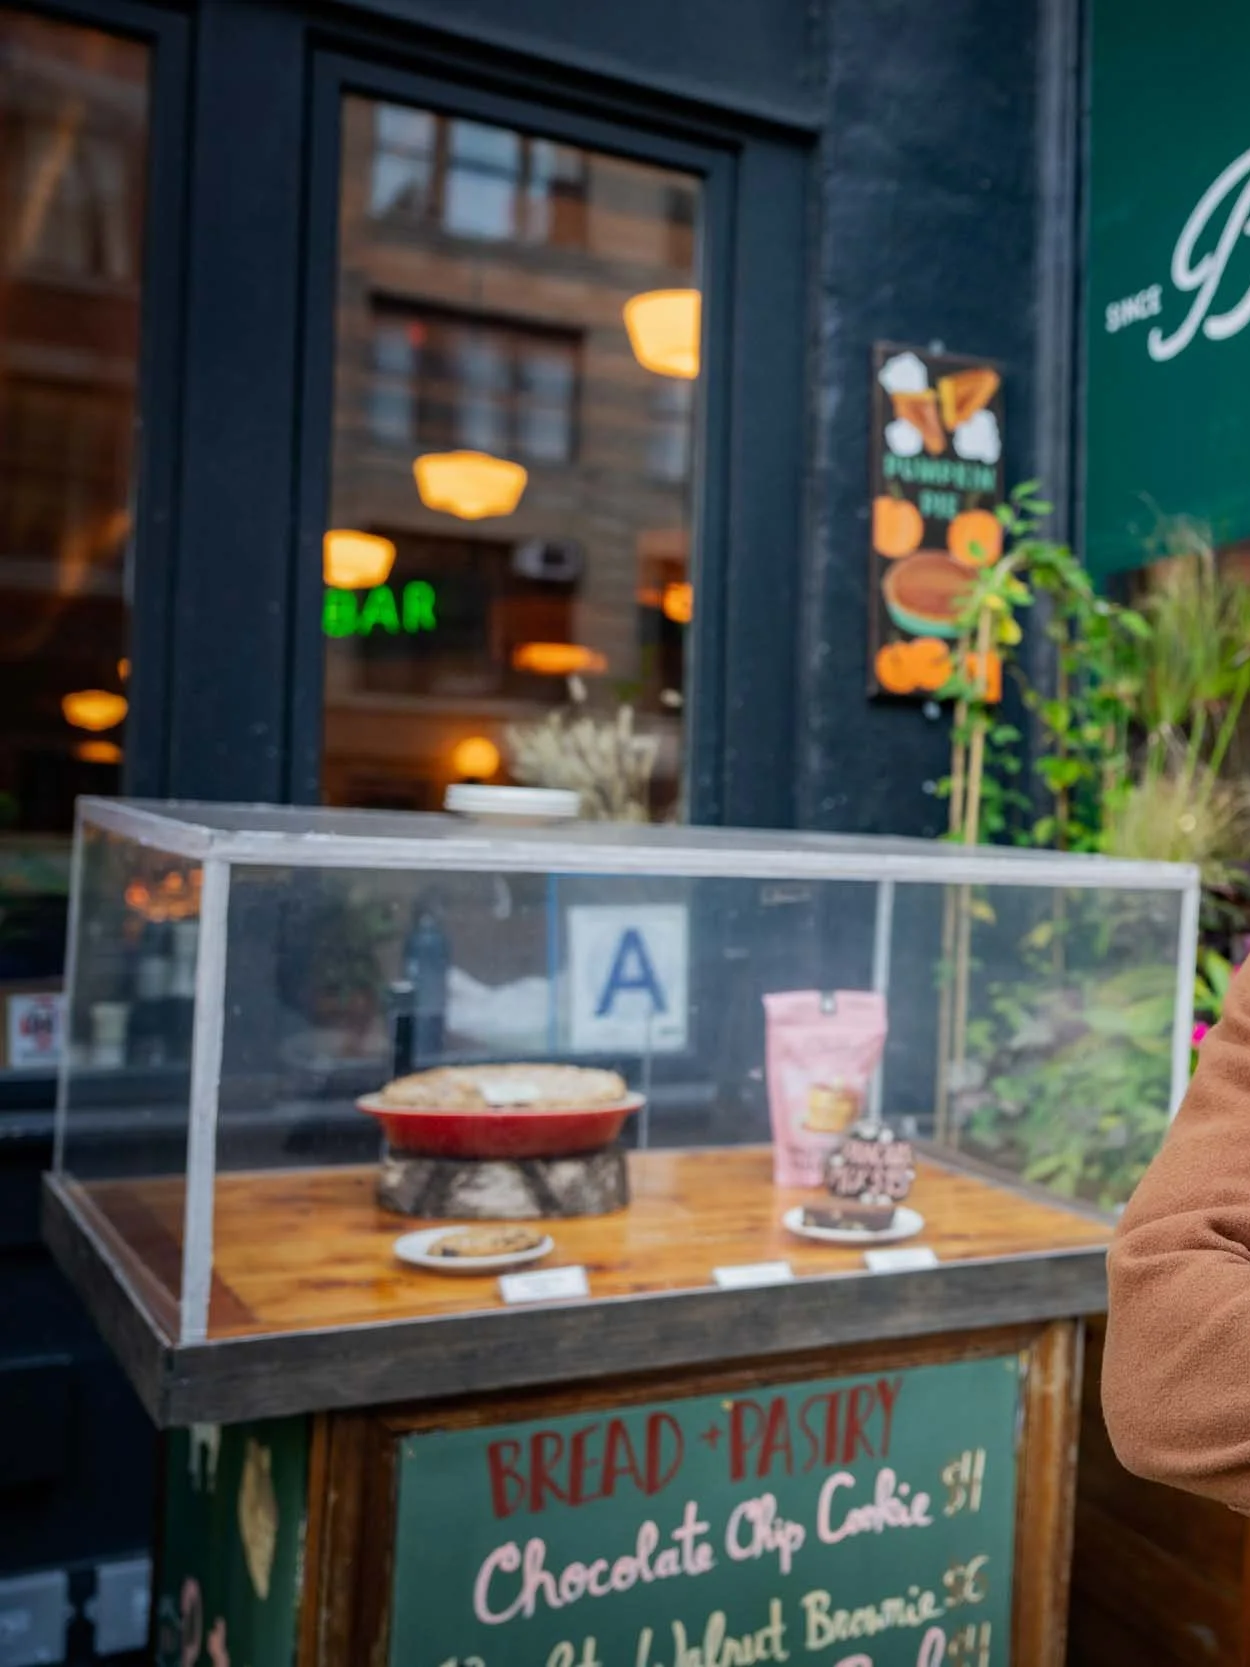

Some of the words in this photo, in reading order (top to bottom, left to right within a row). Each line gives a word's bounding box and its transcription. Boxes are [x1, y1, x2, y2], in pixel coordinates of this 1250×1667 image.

[1105, 283, 1163, 334] SINCE
[322, 580, 437, 637] BAR
[595, 927, 669, 1018] A
[486, 1411, 684, 1519] BREAD
[729, 1376, 904, 1483] PASTRY
[473, 1500, 716, 1625] Chocolate
[725, 1492, 805, 1575] Chip
[816, 1467, 934, 1545] Cookie
[801, 1589, 945, 1651] Brownie
